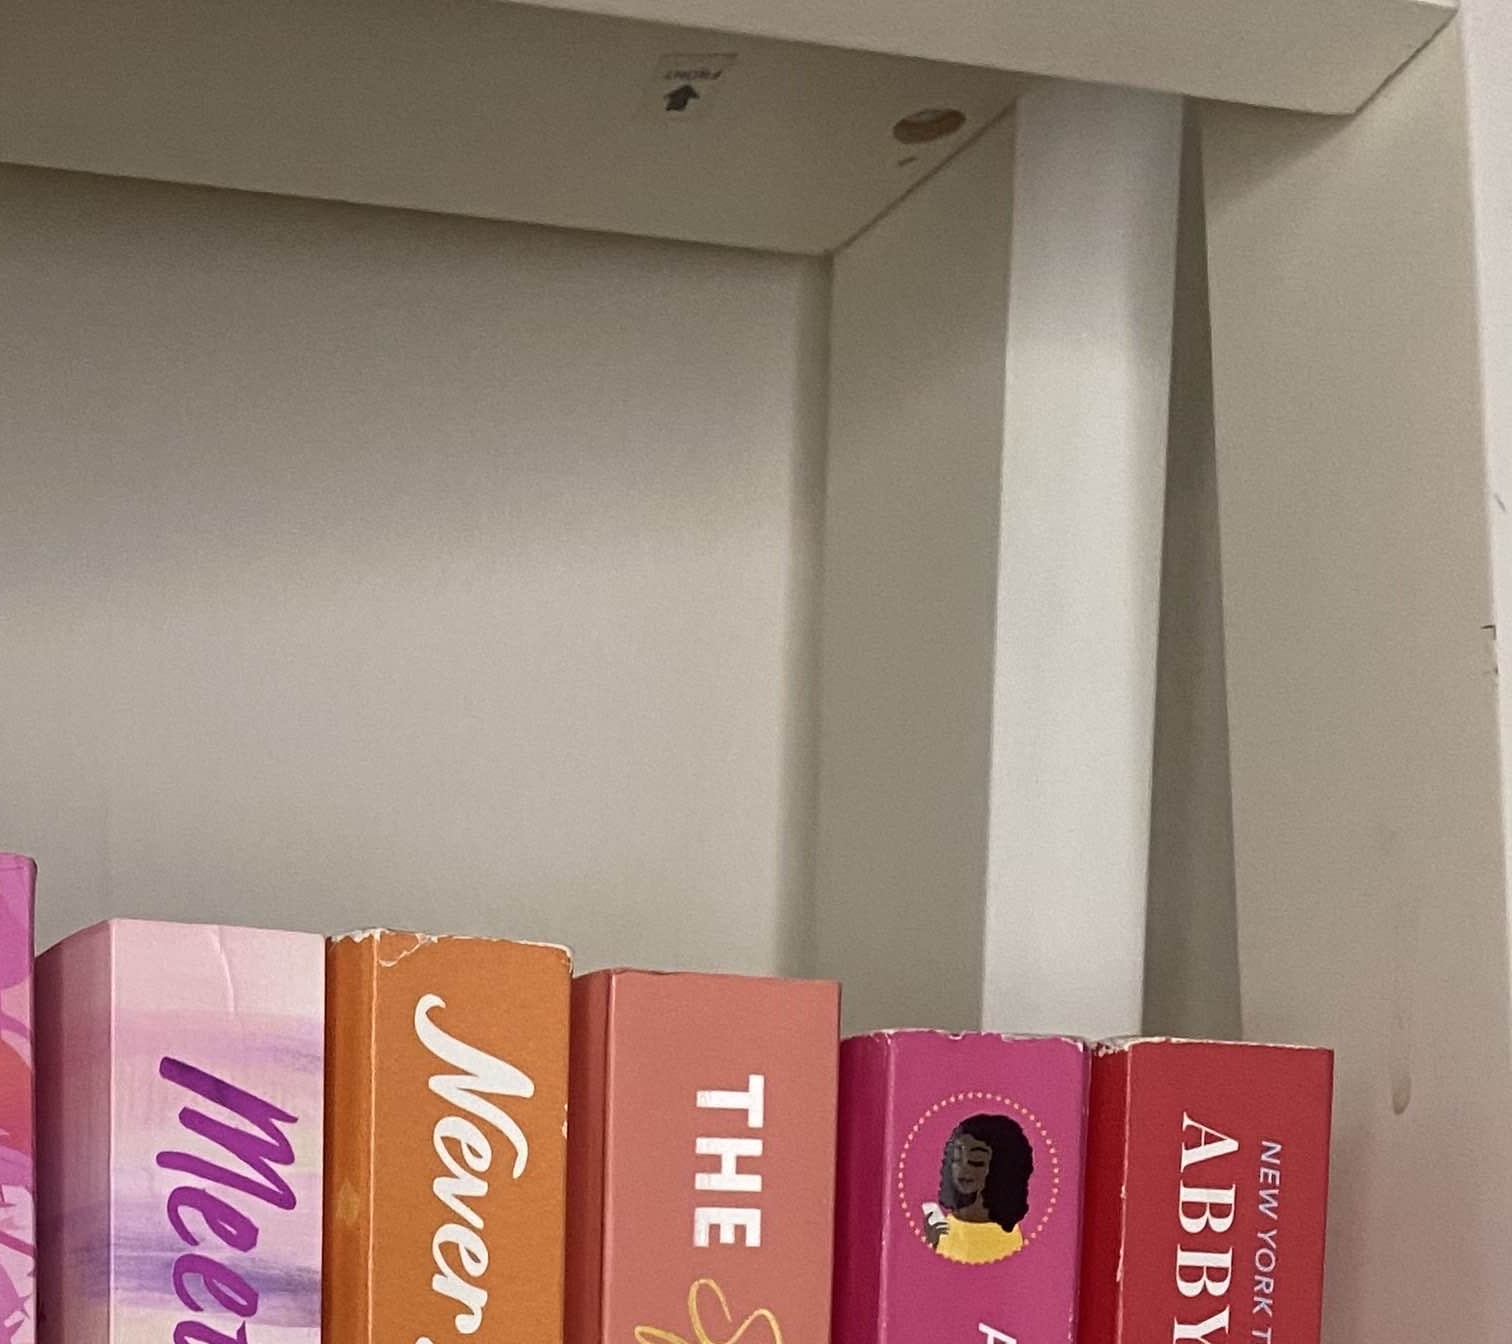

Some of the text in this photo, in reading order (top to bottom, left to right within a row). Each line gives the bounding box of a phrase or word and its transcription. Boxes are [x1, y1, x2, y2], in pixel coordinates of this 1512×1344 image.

[413, 993, 534, 1336] Never
[693, 1074, 766, 1248] THE
[1258, 1138, 1283, 1222] NEW
[1252, 1227, 1278, 1314] YORK
